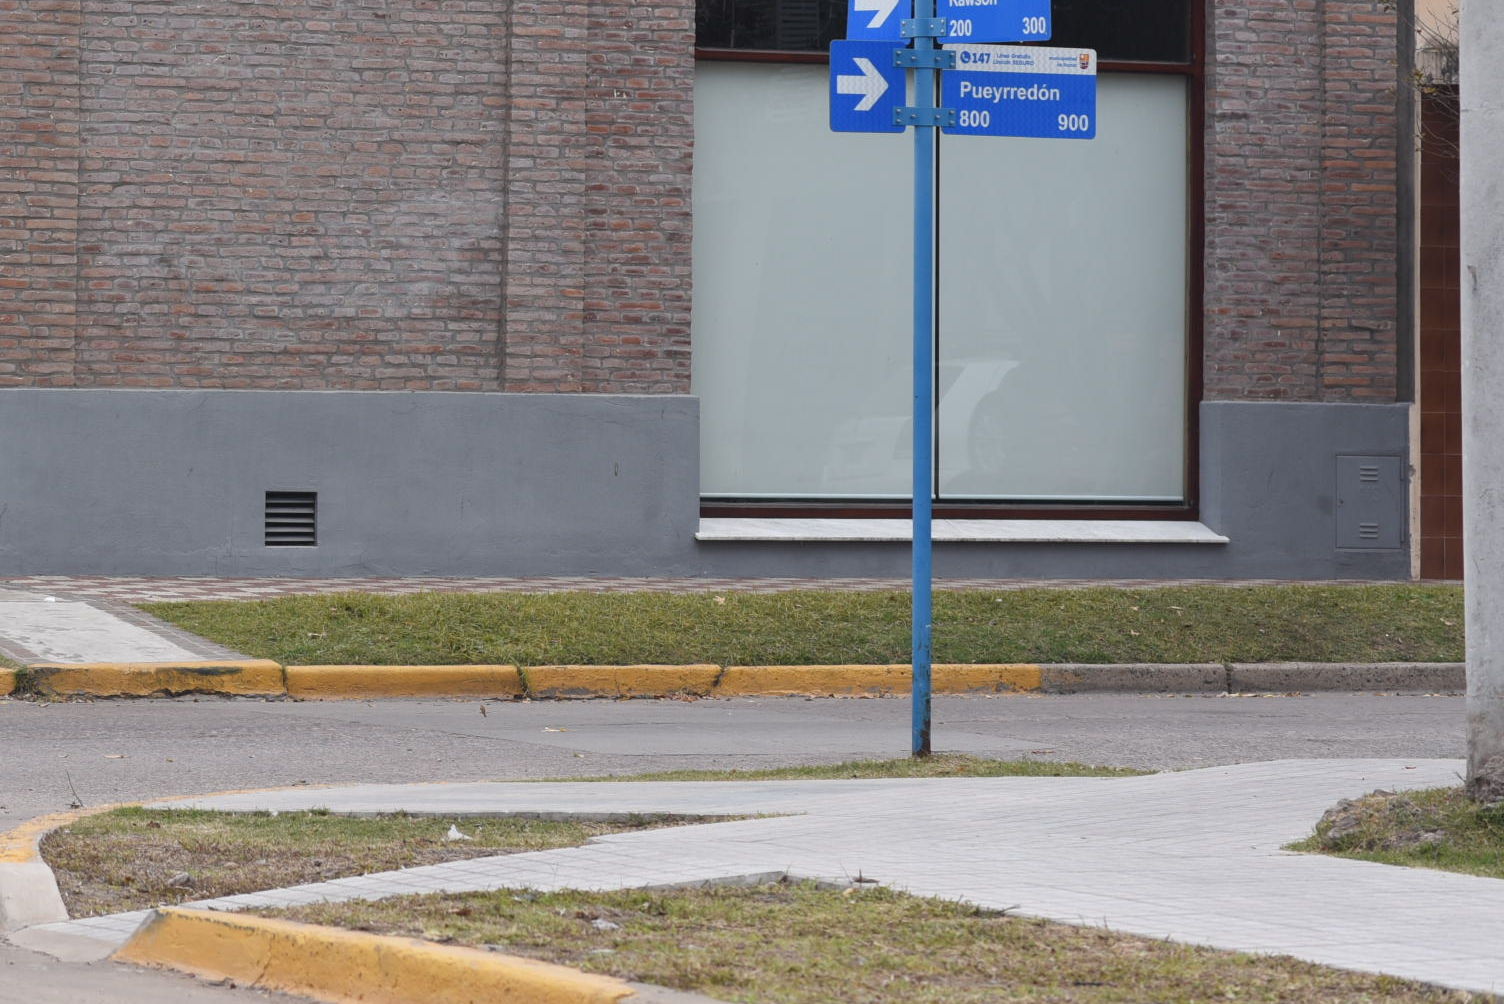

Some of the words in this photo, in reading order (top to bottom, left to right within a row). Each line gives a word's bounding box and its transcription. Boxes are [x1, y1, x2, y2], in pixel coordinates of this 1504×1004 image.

[949, 19, 972, 37] 200
[1022, 16, 1046, 35] 300
[971, 53, 991, 64] 147
[959, 81, 1060, 103] Pueyrredón
[959, 110, 991, 128] 800
[1057, 114, 1089, 132] 900
